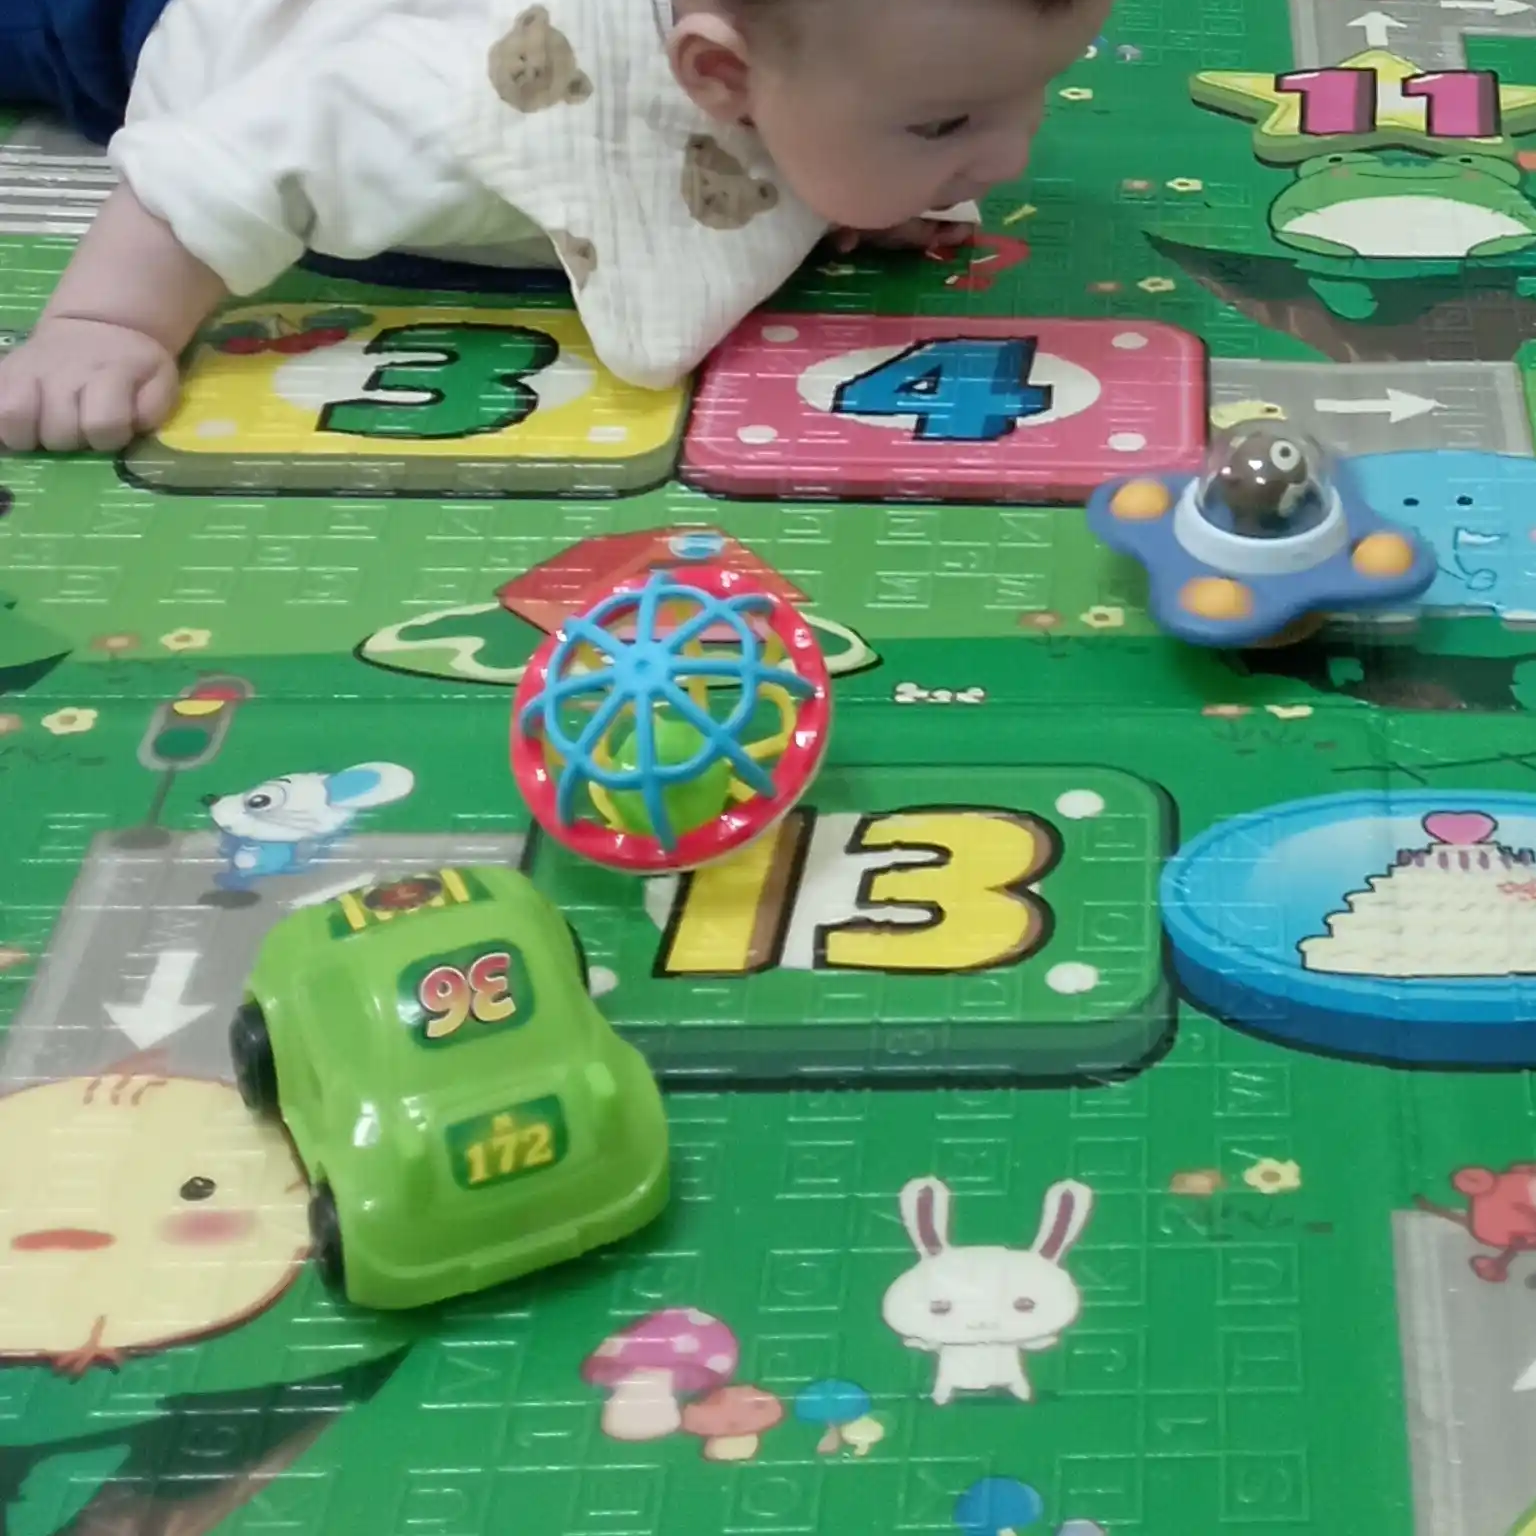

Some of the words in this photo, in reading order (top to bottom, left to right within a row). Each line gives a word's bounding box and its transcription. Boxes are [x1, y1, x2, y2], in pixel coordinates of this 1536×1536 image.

[1273, 67, 1500, 136] 11
[316, 322, 559, 438] 3
[831, 335, 1053, 441] 4
[653, 804, 1064, 977] 13
[464, 1122, 555, 1185] 172
